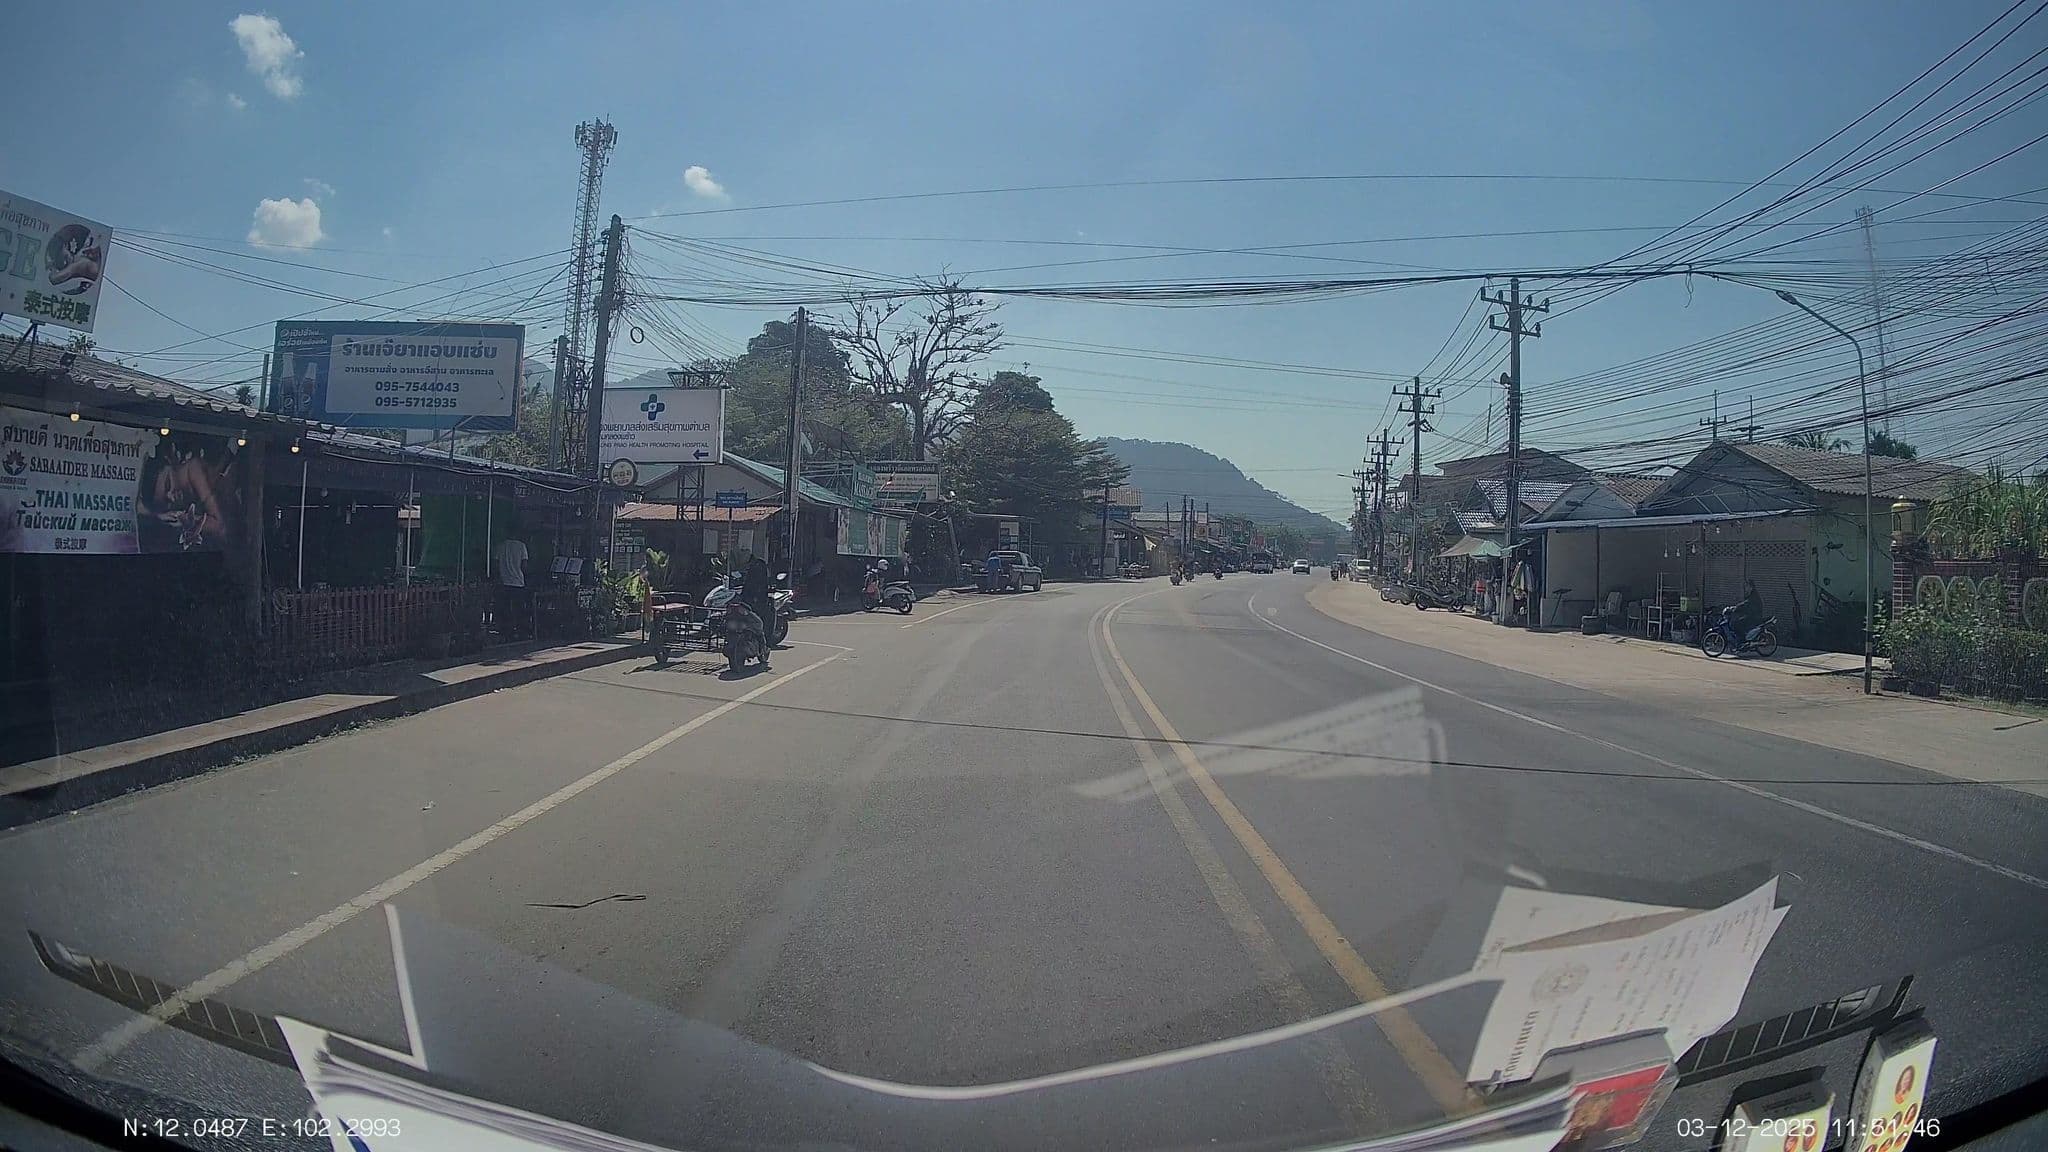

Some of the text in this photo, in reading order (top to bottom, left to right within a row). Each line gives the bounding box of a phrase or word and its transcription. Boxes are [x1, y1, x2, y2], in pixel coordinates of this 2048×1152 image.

[23, 289, 91, 324] 泰式按摩
[344, 362, 398, 374] อาหารตามสั่ง
[449, 368, 494, 376] อาหารทะเล
[375, 381, 460, 393] 095-7544043
[375, 396, 457, 409] 095-5712935
[3, 424, 141, 460] สบายดี นวดเพื่อสุขภาพ
[29, 456, 136, 481] SABAAIDEE MASSAGE
[36, 489, 131, 512] THAI MASSAGE
[15, 508, 131, 533] Тайский массаж
